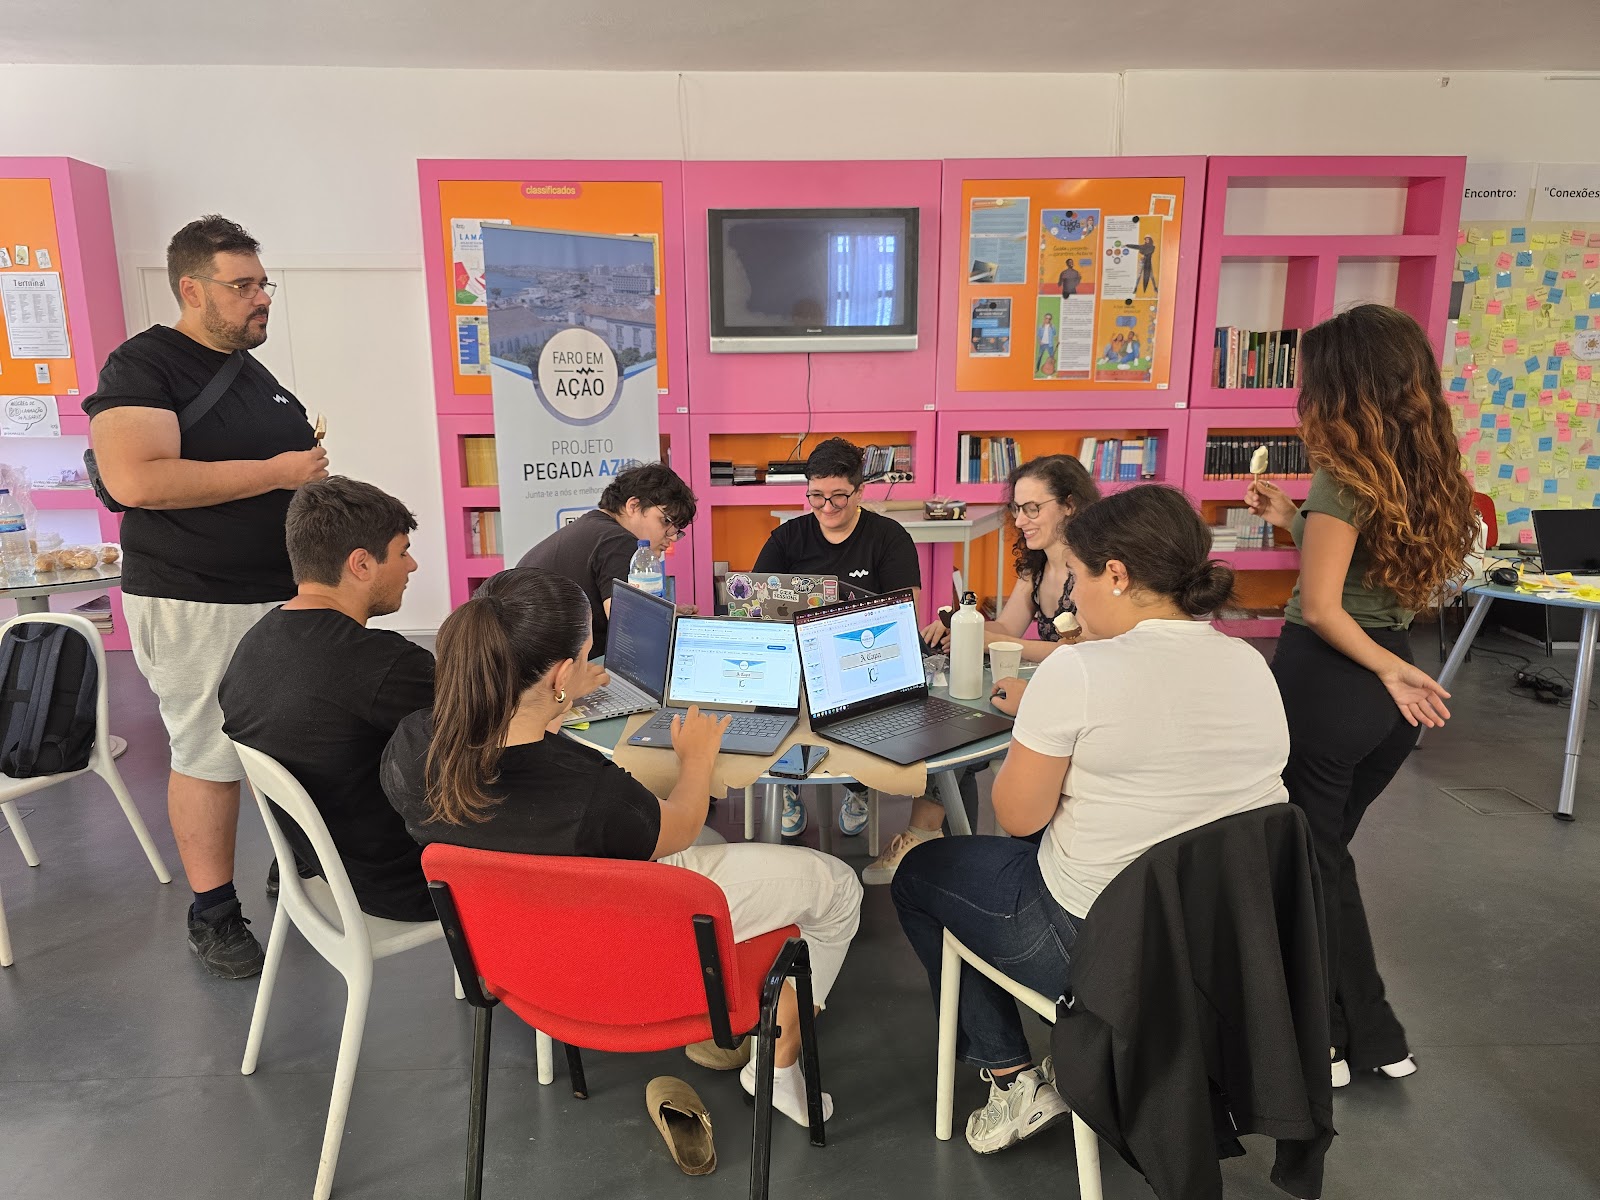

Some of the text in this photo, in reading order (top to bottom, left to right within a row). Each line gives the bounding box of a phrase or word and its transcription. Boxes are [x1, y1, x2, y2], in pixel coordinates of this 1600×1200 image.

[525, 185, 576, 195] classificados
[1464, 188, 1517, 198] Encontro:
[13, 279, 46, 287] Terminal
[552, 351, 604, 365] FARO EM
[551, 438, 614, 455] PROJETO
[523, 460, 594, 481] PEGADA
[525, 490, 553, 499] Junta-te
